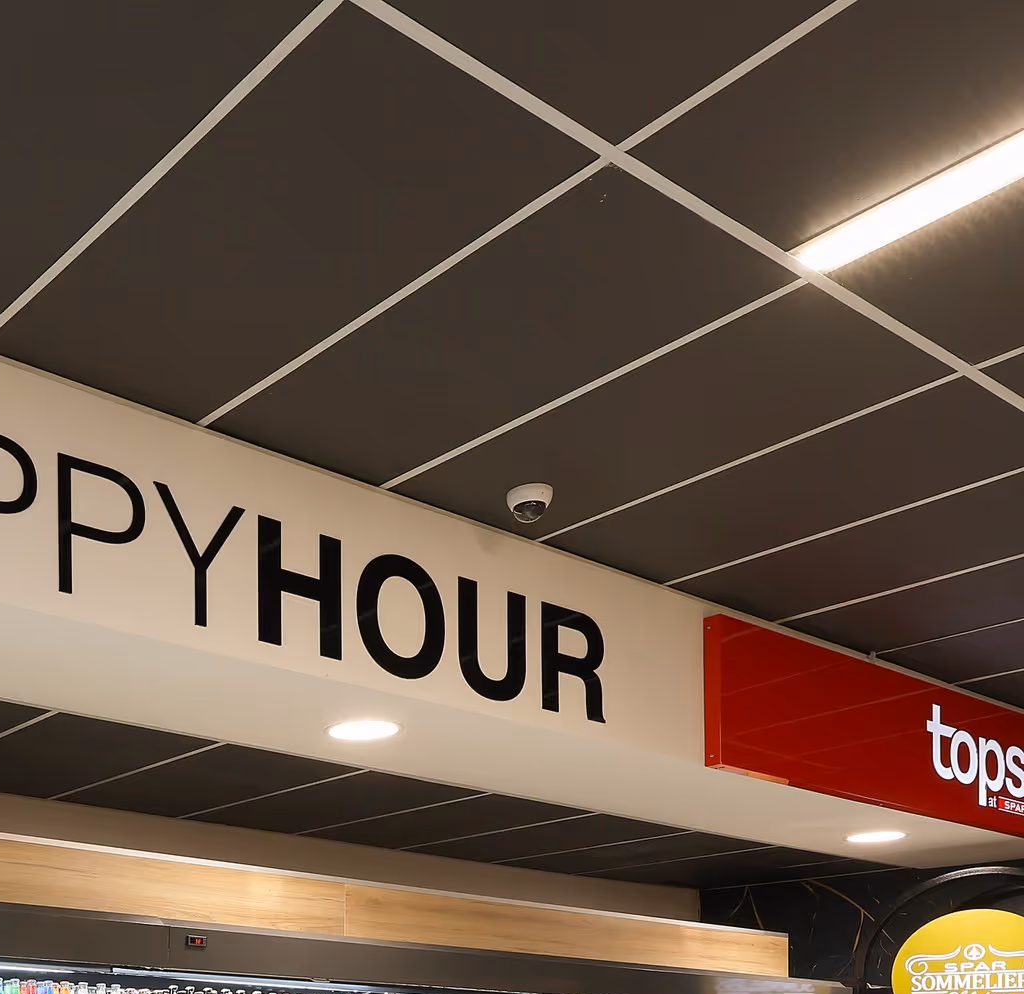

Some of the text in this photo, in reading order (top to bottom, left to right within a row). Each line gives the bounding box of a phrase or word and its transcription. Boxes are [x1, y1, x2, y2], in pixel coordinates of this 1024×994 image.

[926, 703, 1024, 807] tops
[988, 796, 997, 808] at
[944, 960, 1006, 972] SPAR
